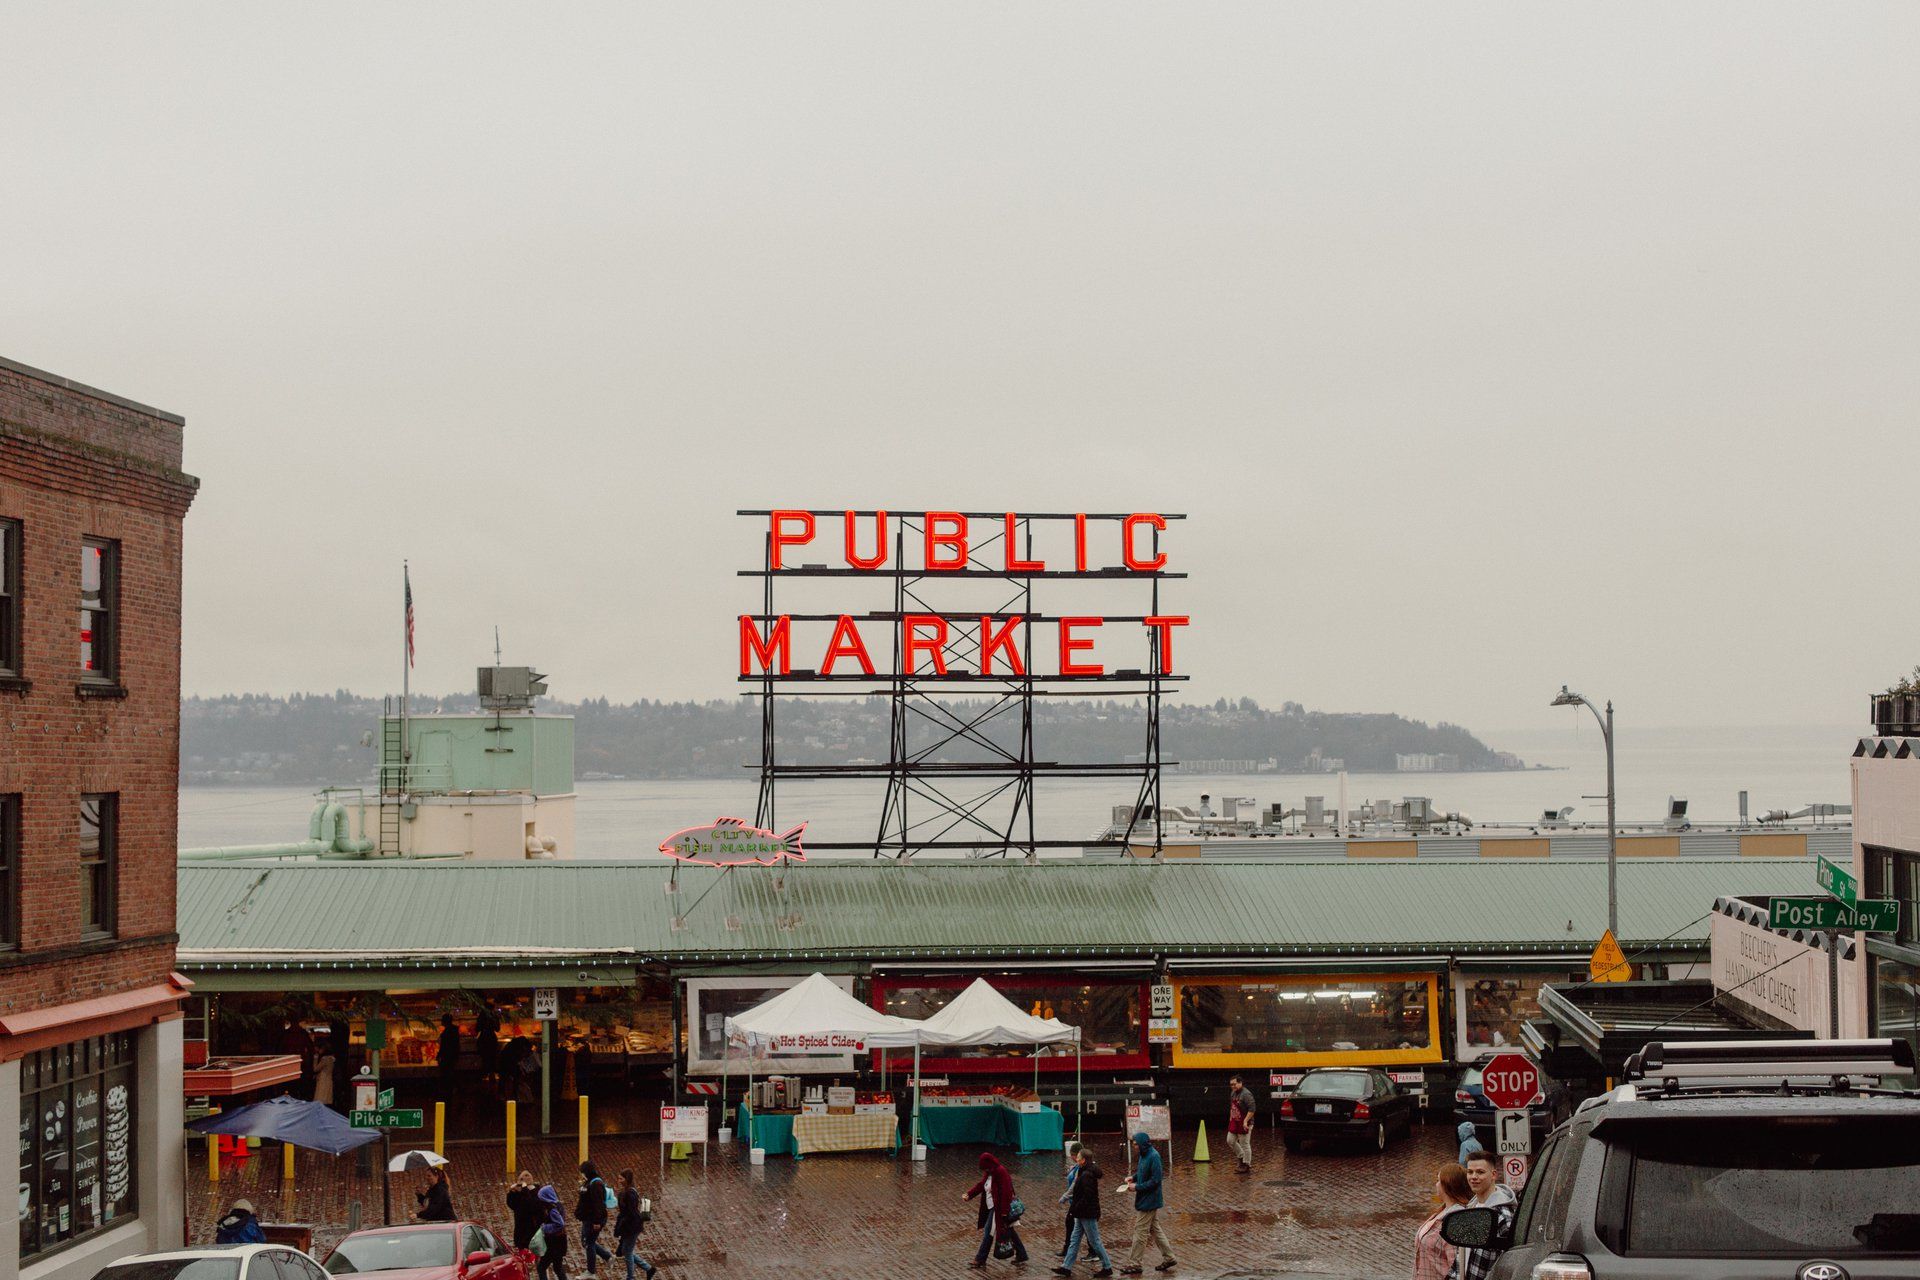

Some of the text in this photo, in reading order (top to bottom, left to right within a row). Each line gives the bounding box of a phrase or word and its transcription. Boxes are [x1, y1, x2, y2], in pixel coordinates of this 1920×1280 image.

[770, 509, 1168, 572] PUBLIC
[739, 614, 1190, 676] MARKET
[711, 829, 755, 840] CITY
[674, 843, 790, 853] FISH MARKET
[1820, 858, 1834, 890] Pine
[1839, 880, 1846, 899] St
[1775, 900, 1896, 930] Post Alley 75
[1602, 943, 1616, 952] YIELD
[1740, 930, 1778, 970] BEECHER'S
[1605, 953, 1612, 962] TO
[1153, 987, 1171, 995] ONE
[1725, 957, 1797, 1015] HANDMADE CHEESE
[536, 990, 555, 999] ONE
[1153, 996, 1171, 1004] WAY
[536, 999, 555, 1007] WAY
[780, 1035, 856, 1050] Hot Spiced Cider
[1272, 1076, 1282, 1085] NO
[1486, 1070, 1535, 1093] STOP
[76, 1089, 98, 1109] Cookie
[354, 1111, 421, 1126] Pike Pl 60
[662, 1109, 675, 1118] NO
[1127, 1107, 1139, 1117] NO
[1500, 1141, 1528, 1152] ONLY
[75, 1156, 99, 1173] BAKERY
[77, 1174, 96, 1190] SINCE
